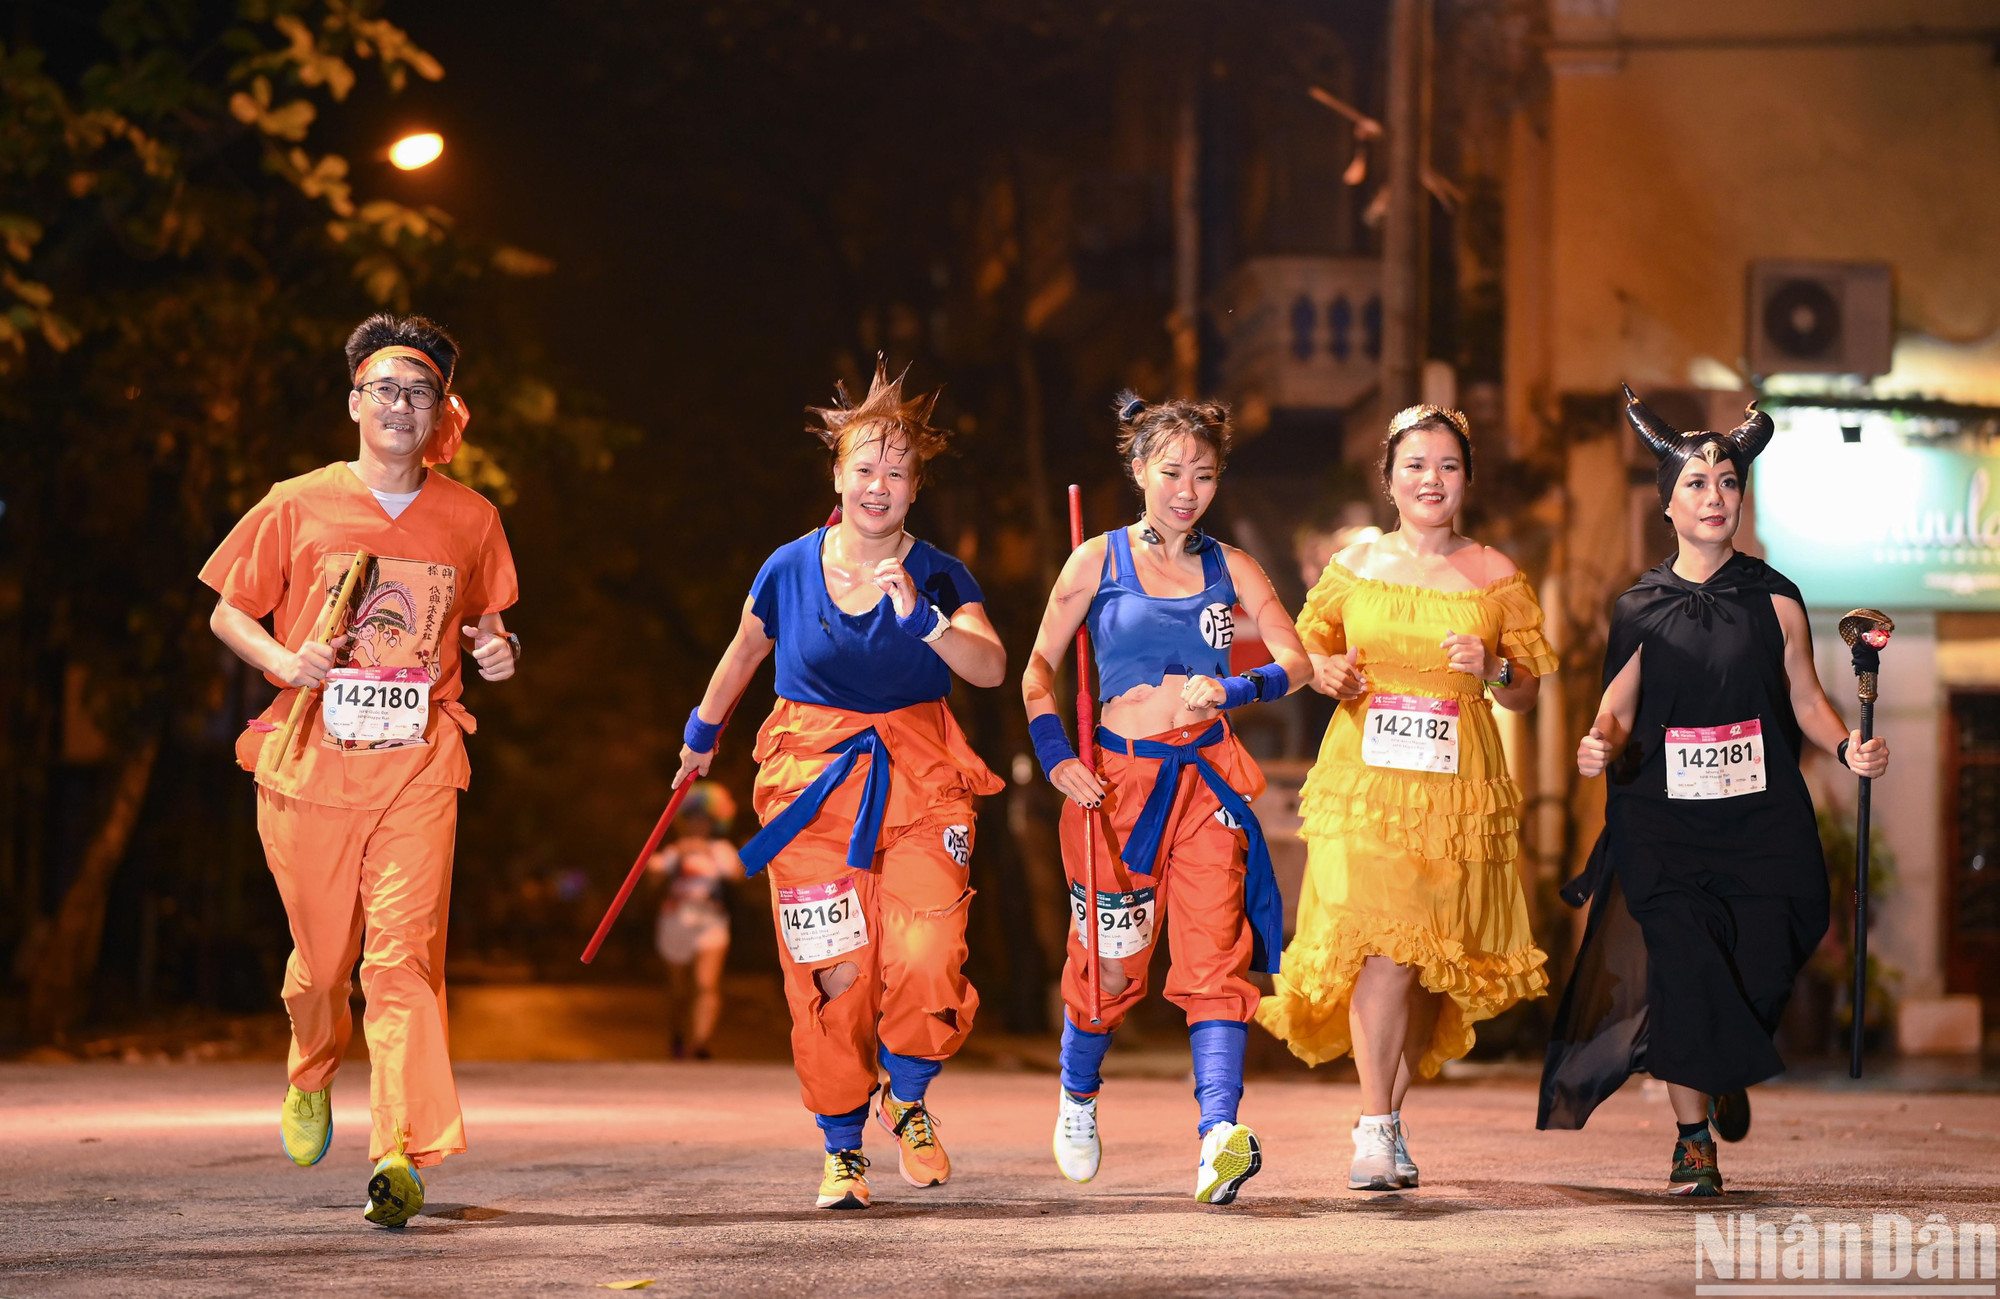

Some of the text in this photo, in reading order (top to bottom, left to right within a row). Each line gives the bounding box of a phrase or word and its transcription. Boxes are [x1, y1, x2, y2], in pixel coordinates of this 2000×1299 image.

[1206, 606, 1234, 649] 悟
[333, 683, 420, 710] 142180
[1375, 713, 1450, 741] 142182
[1729, 725, 1743, 736] 42
[1678, 742, 1753, 768] 142181
[824, 883, 839, 897] 42
[1119, 894, 1135, 905] 42
[784, 897, 849, 930] 142167
